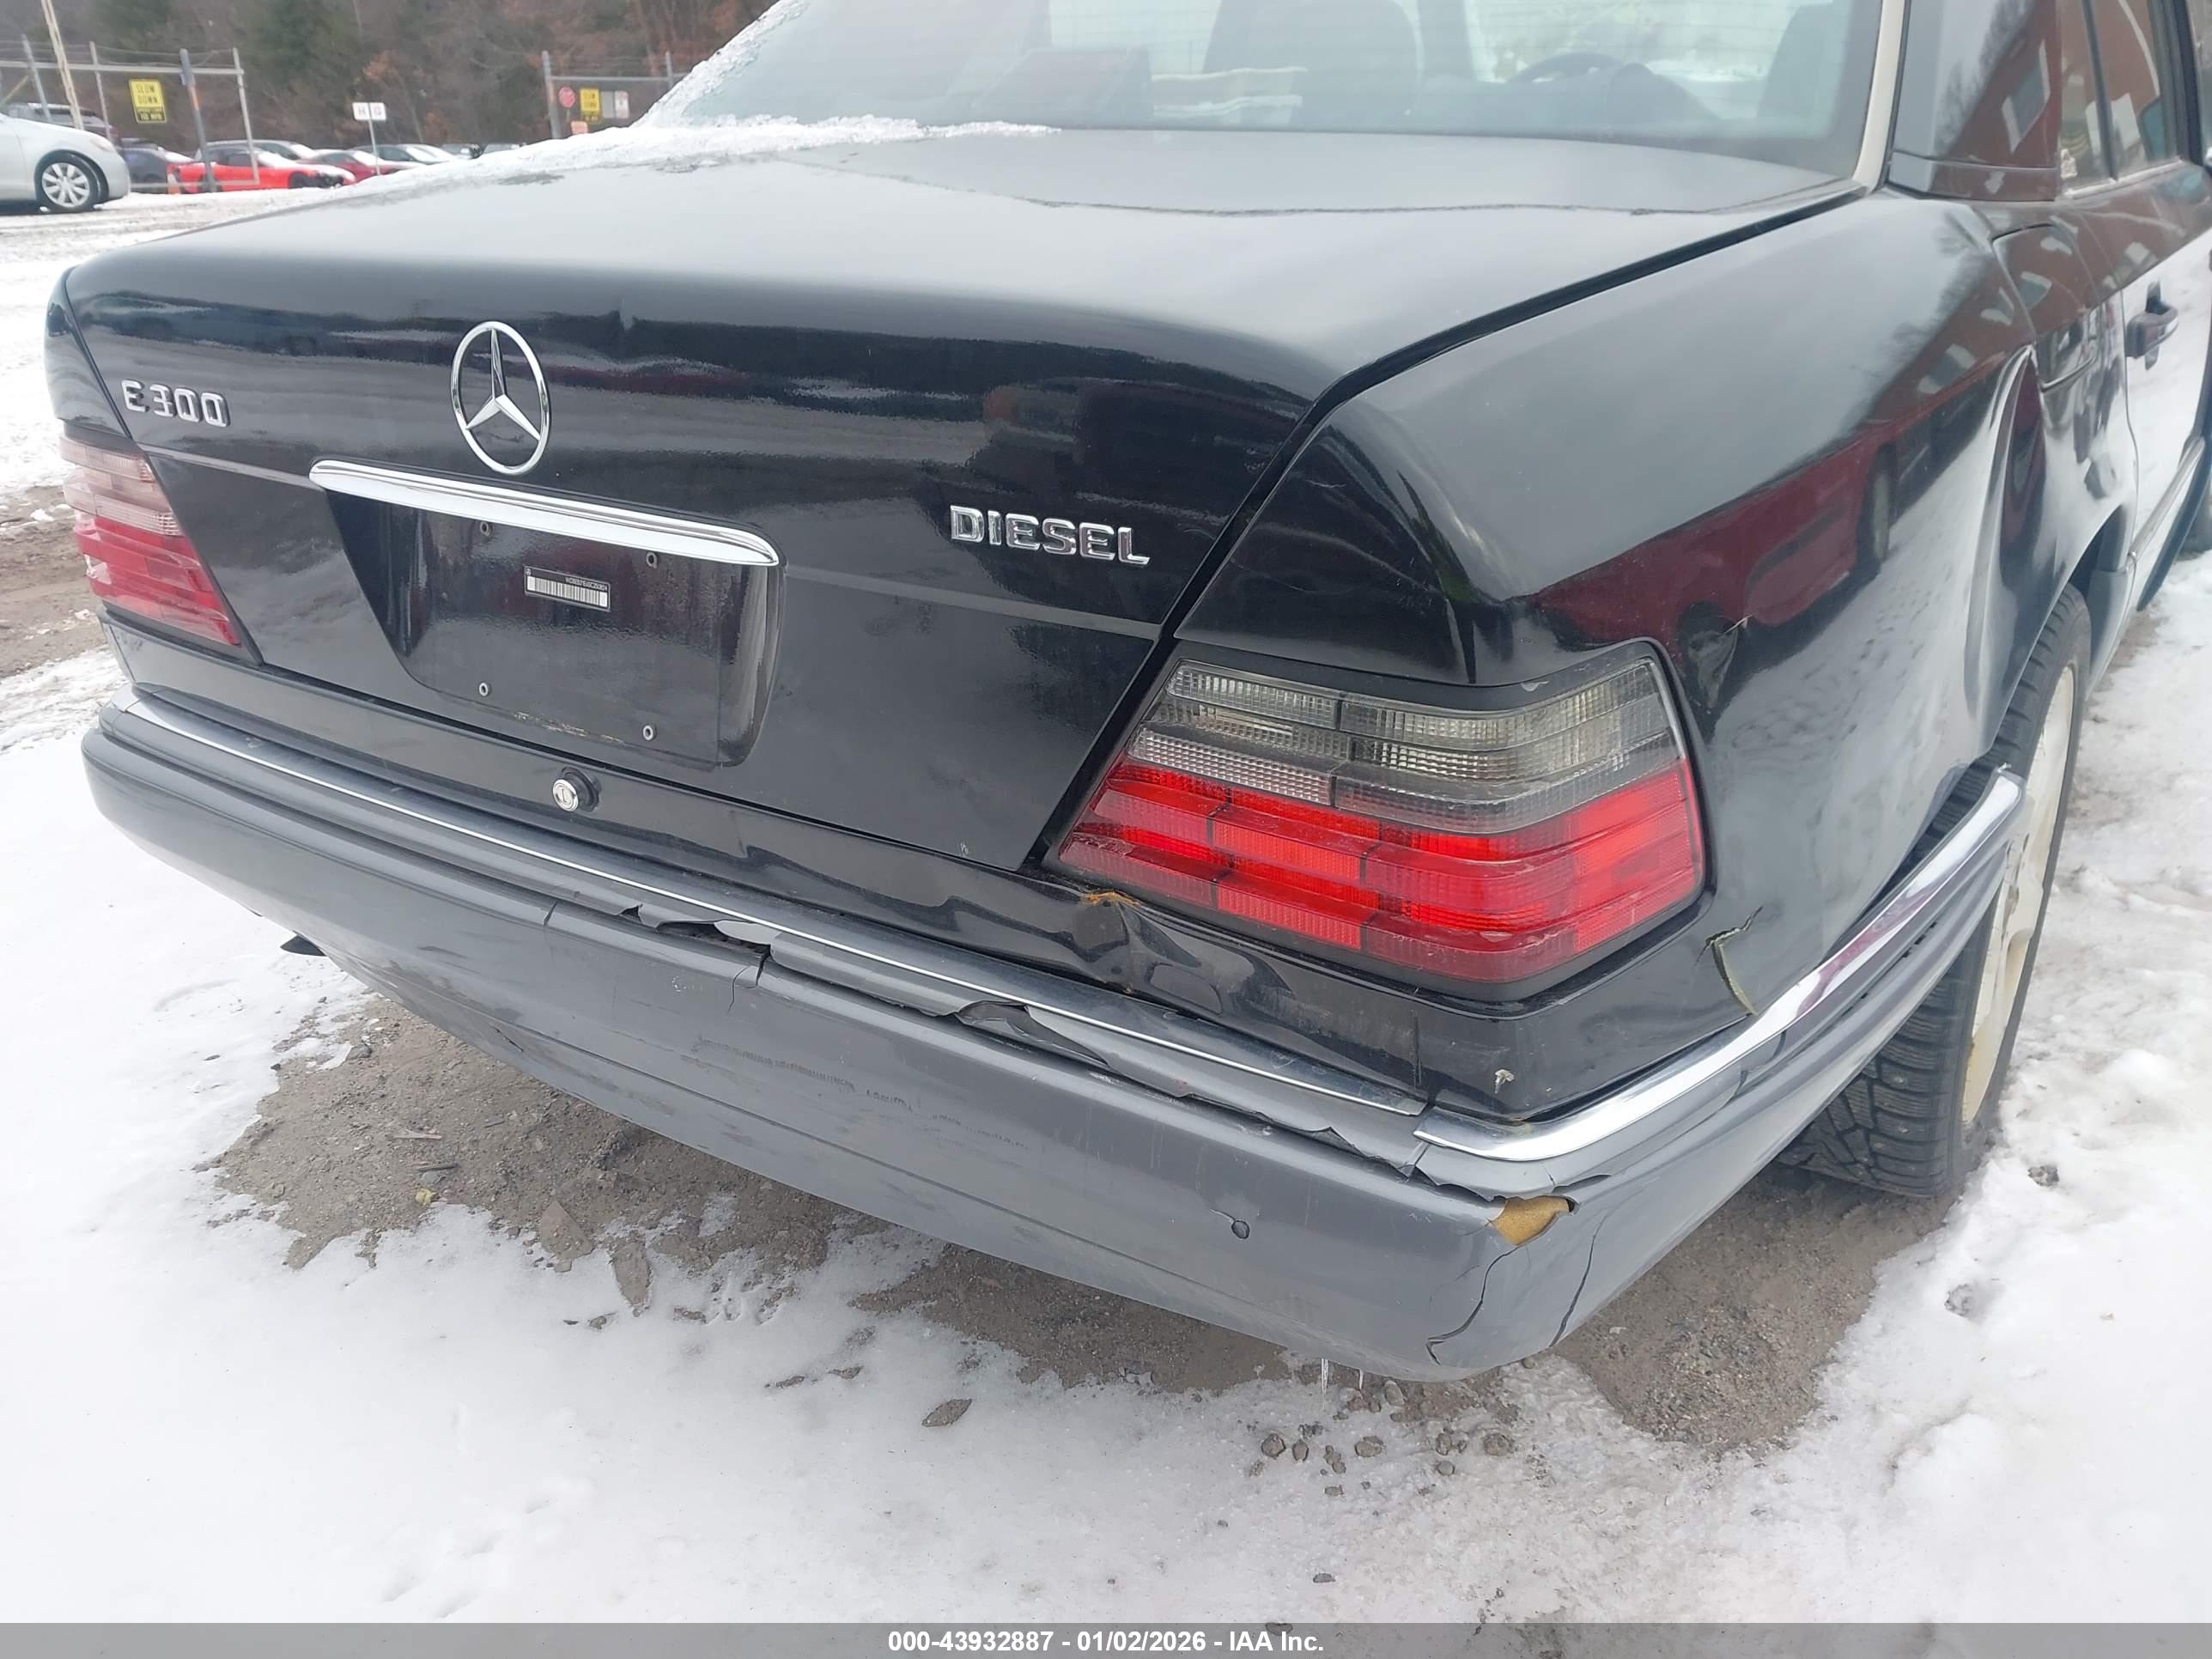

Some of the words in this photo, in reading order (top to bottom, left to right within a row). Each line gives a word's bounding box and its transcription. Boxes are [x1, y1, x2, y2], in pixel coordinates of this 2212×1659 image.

[121, 379, 149, 412] E
[149, 384, 230, 428] 300
[950, 505, 1151, 565] DIESEL
